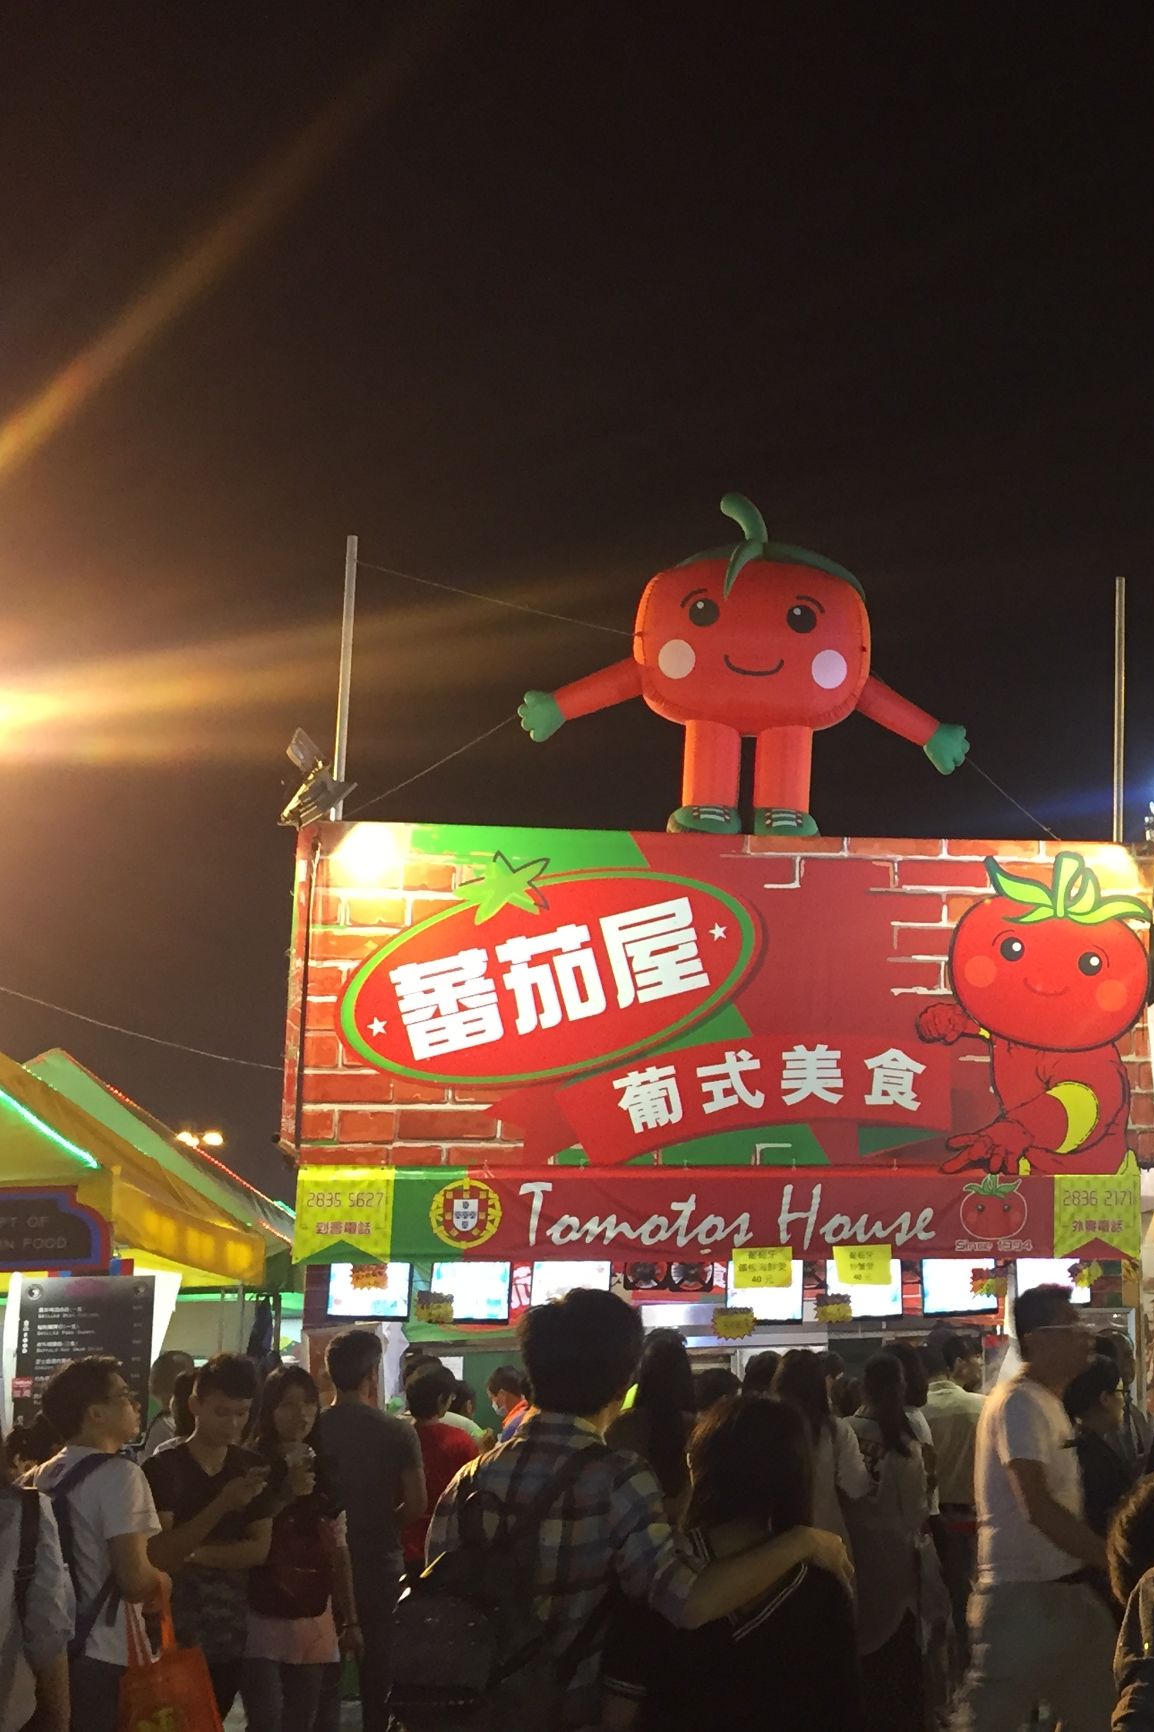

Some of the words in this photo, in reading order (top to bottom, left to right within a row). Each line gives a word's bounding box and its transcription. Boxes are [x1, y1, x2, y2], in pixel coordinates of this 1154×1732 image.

[389, 897, 710, 1061] 蕃茄屋
[613, 1044, 926, 1133] 葡式美食
[306, 1191, 342, 1208] 2835
[348, 1191, 384, 1209] 5627
[1063, 1190, 1098, 1207] 2836
[26, 1215, 49, 1228] OF
[519, 1182, 752, 1248] Tomotos
[778, 1183, 936, 1250] House
[23, 1236, 67, 1249] FOOD
[955, 1239, 993, 1251] Since
[997, 1239, 1033, 1251] 1994
